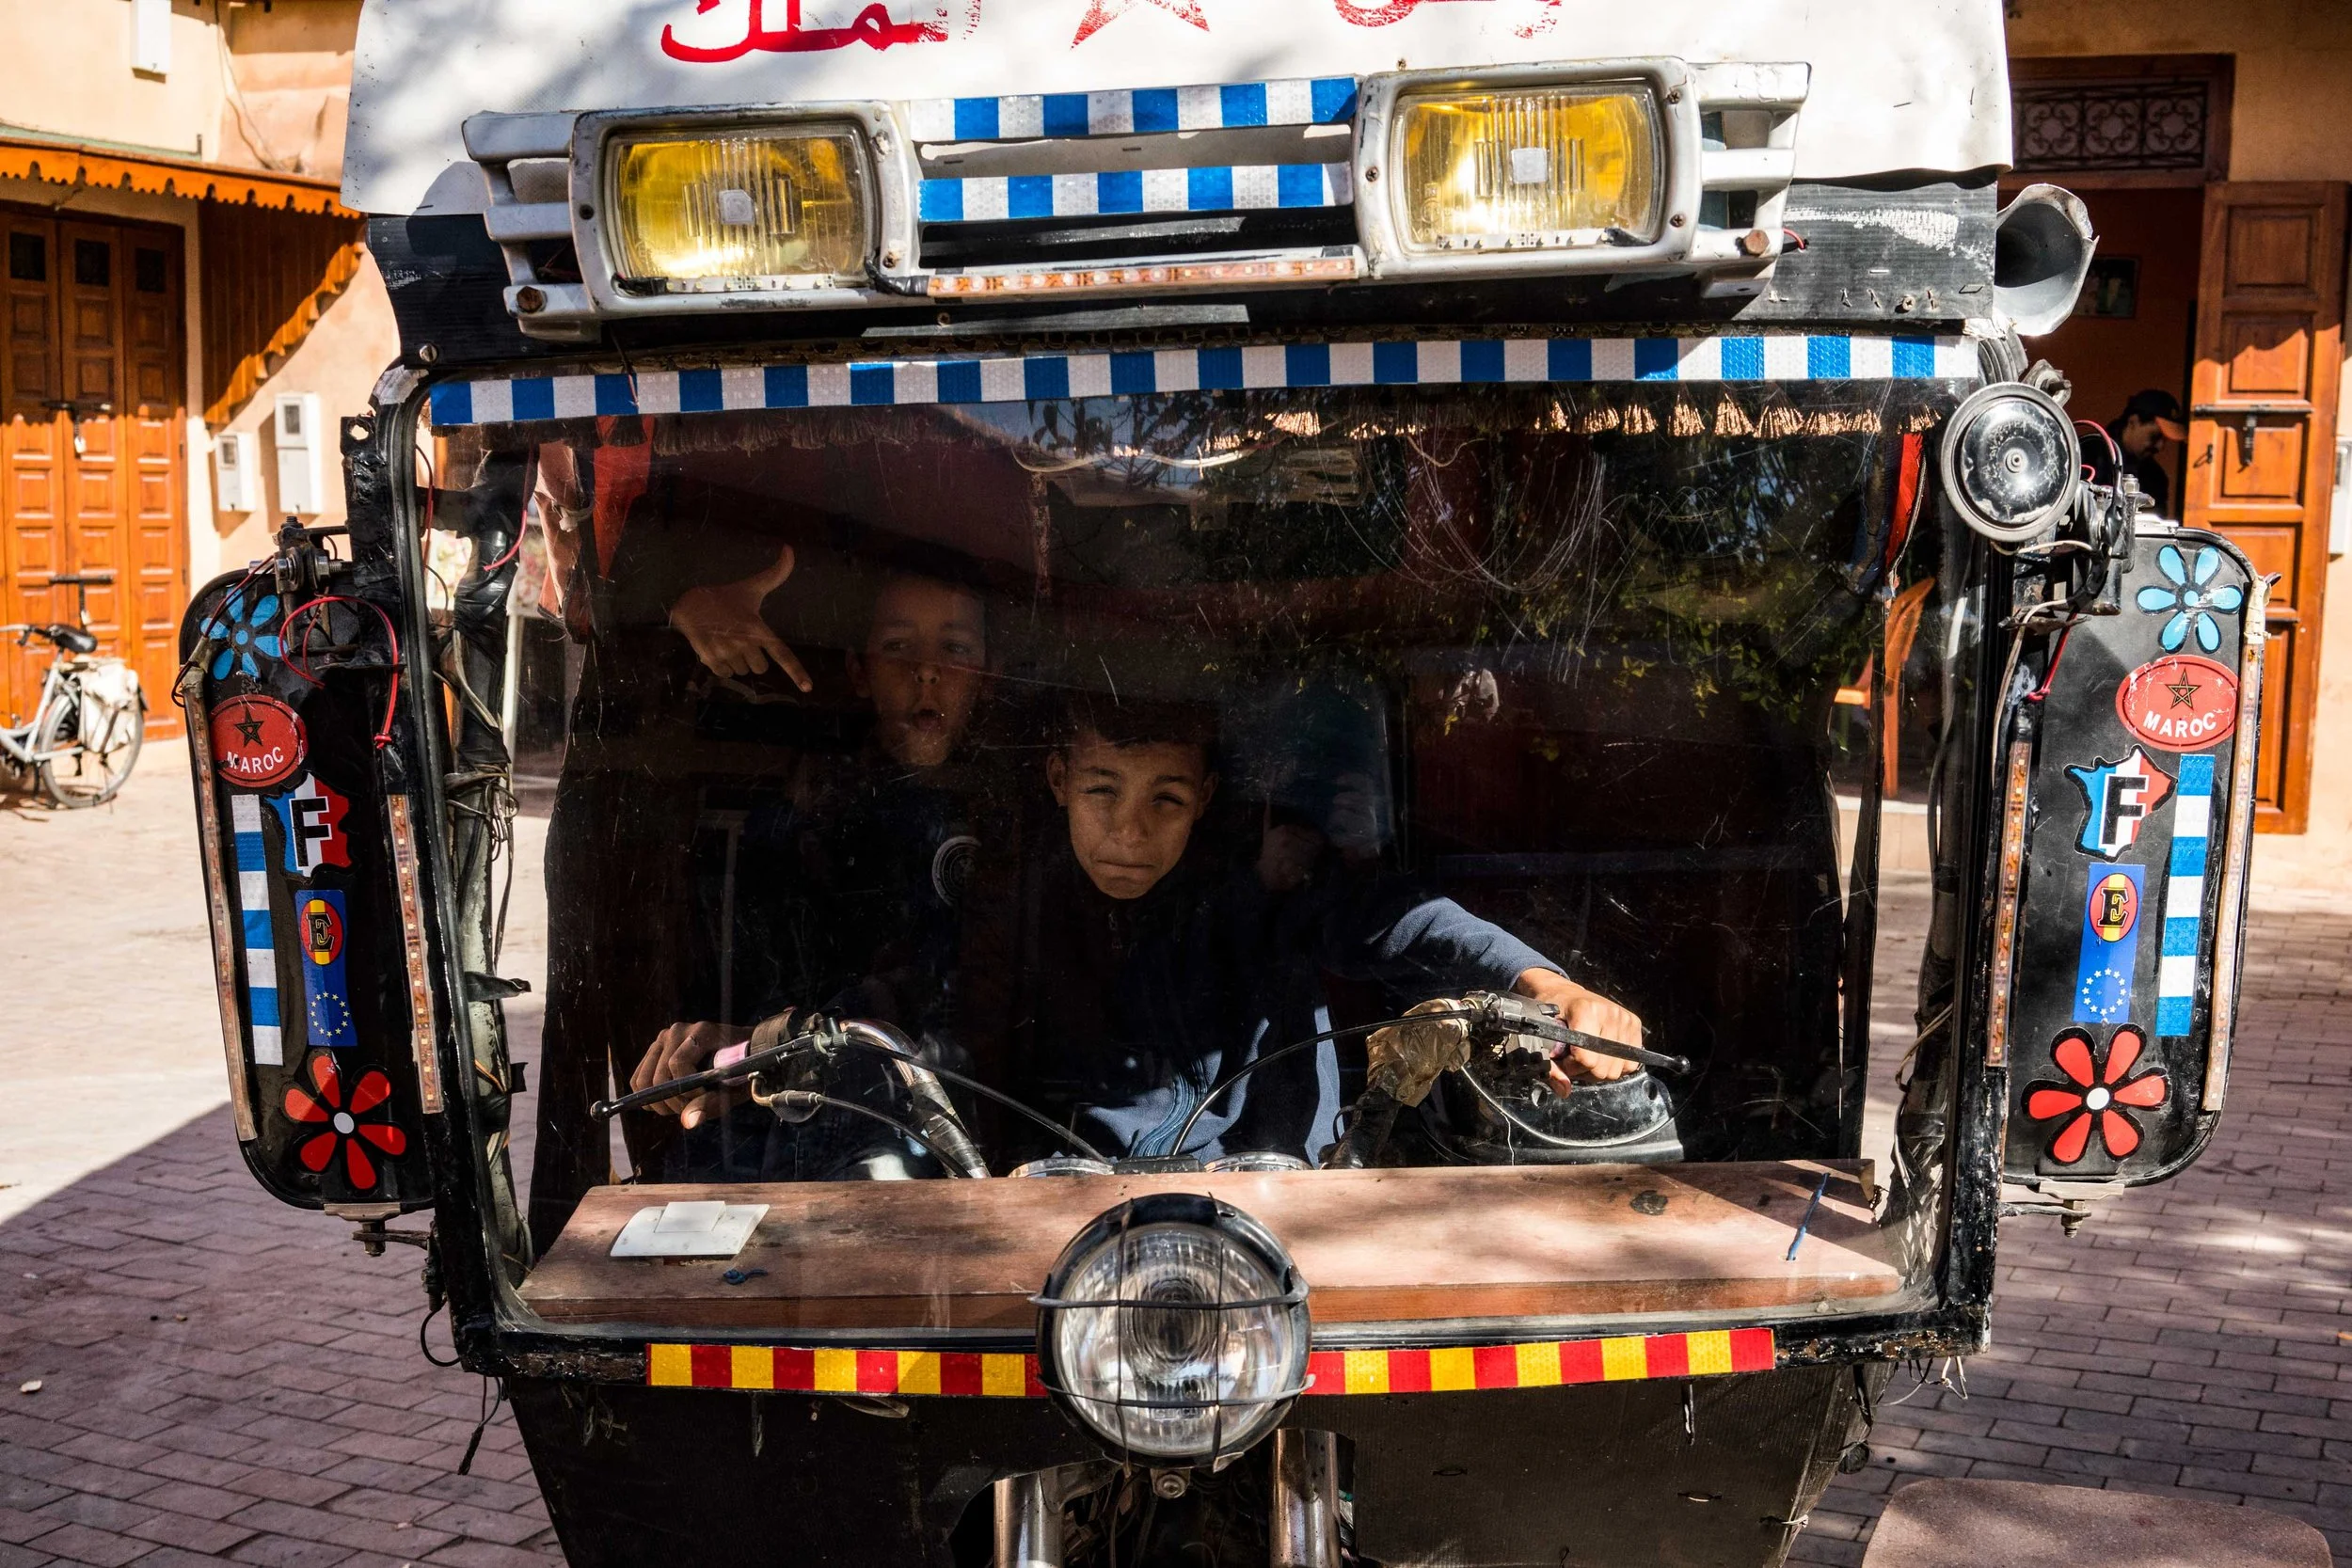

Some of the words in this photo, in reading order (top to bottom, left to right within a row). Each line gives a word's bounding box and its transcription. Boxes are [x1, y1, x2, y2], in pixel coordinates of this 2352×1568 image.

[2143, 710, 2217, 738] MAROC
[227, 746, 284, 773] MAROC
[2099, 774, 2148, 847] F
[290, 797, 331, 869] F
[2098, 887, 2129, 927] E
[306, 911, 335, 953] E
